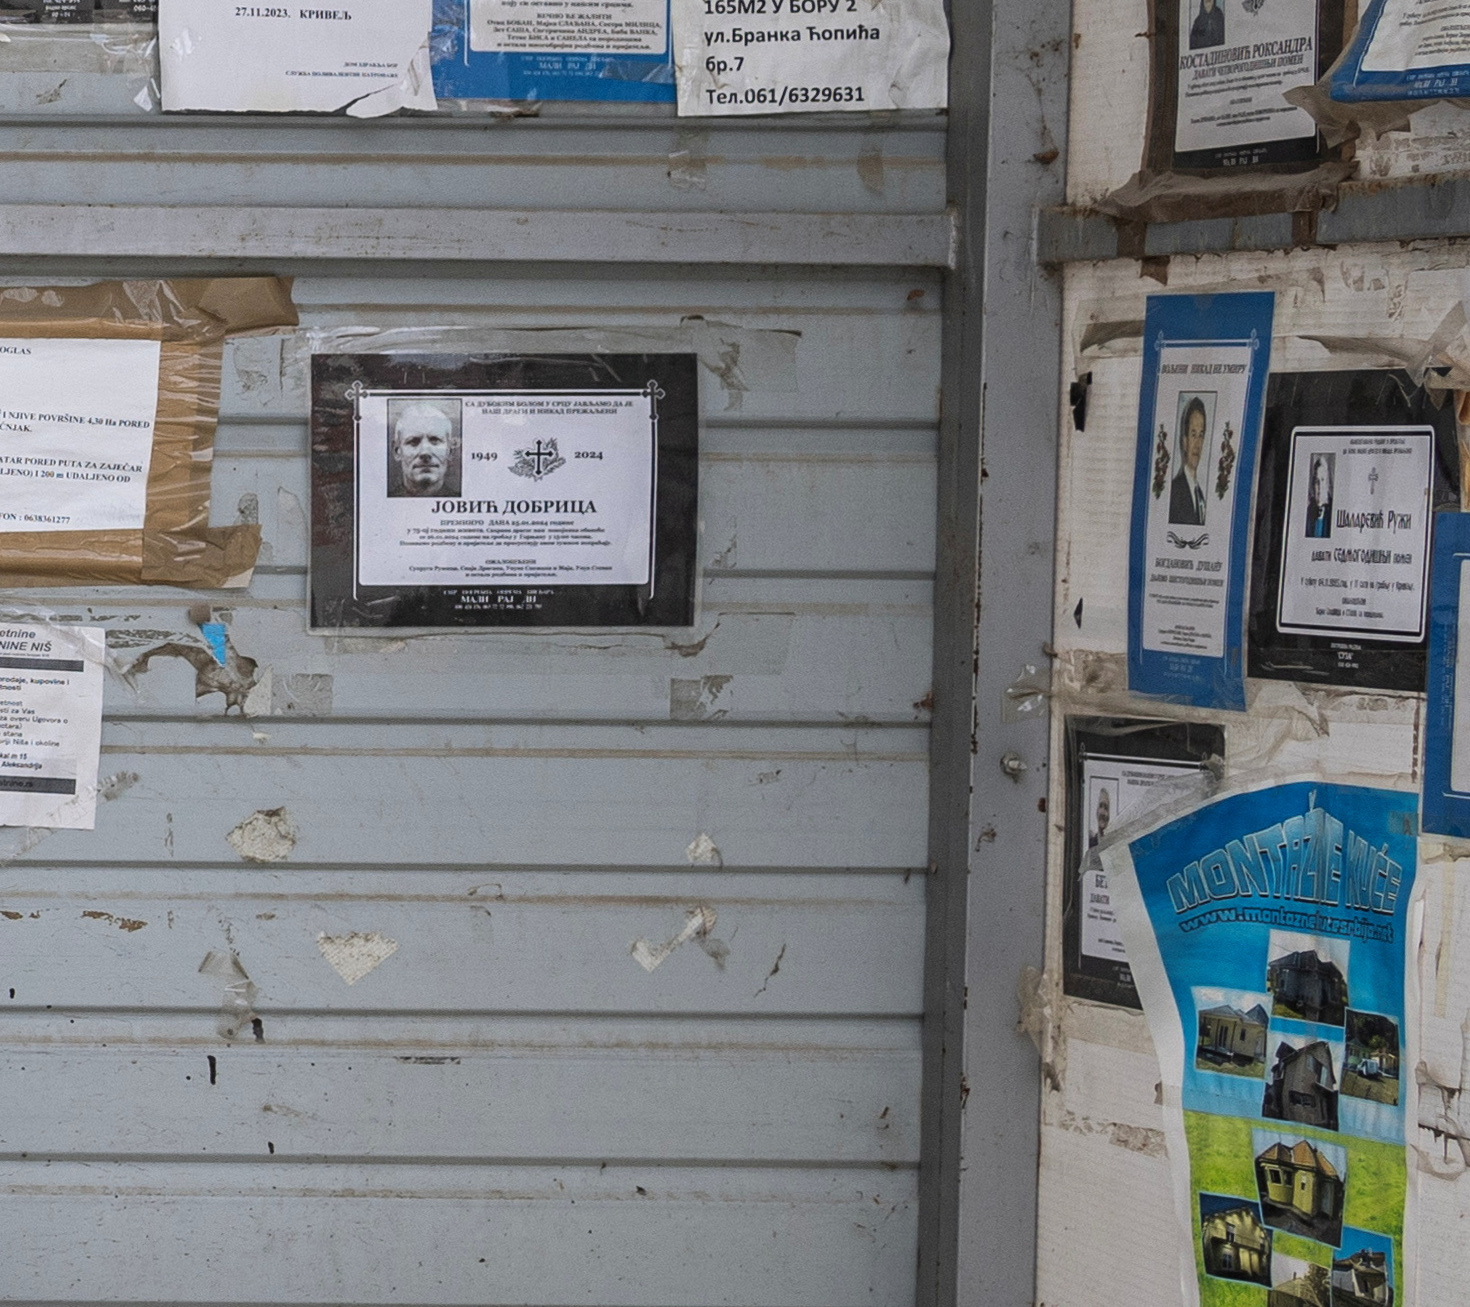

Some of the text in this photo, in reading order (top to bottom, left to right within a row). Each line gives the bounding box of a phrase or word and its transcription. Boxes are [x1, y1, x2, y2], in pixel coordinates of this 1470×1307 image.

[773, 0, 783, 13] У
[704, 24, 880, 46] ул.Бранка Ћопића
[706, 57, 744, 75] бр.7
[706, 86, 864, 106] Тел.061/6329631
[0, 346, 31, 355] OGLAS
[431, 500, 596, 516] ЈОВИЋ ДОБРИЦА
[1388, 511, 1411, 534] Ружи
[30, 640, 51, 652] NIŠ
